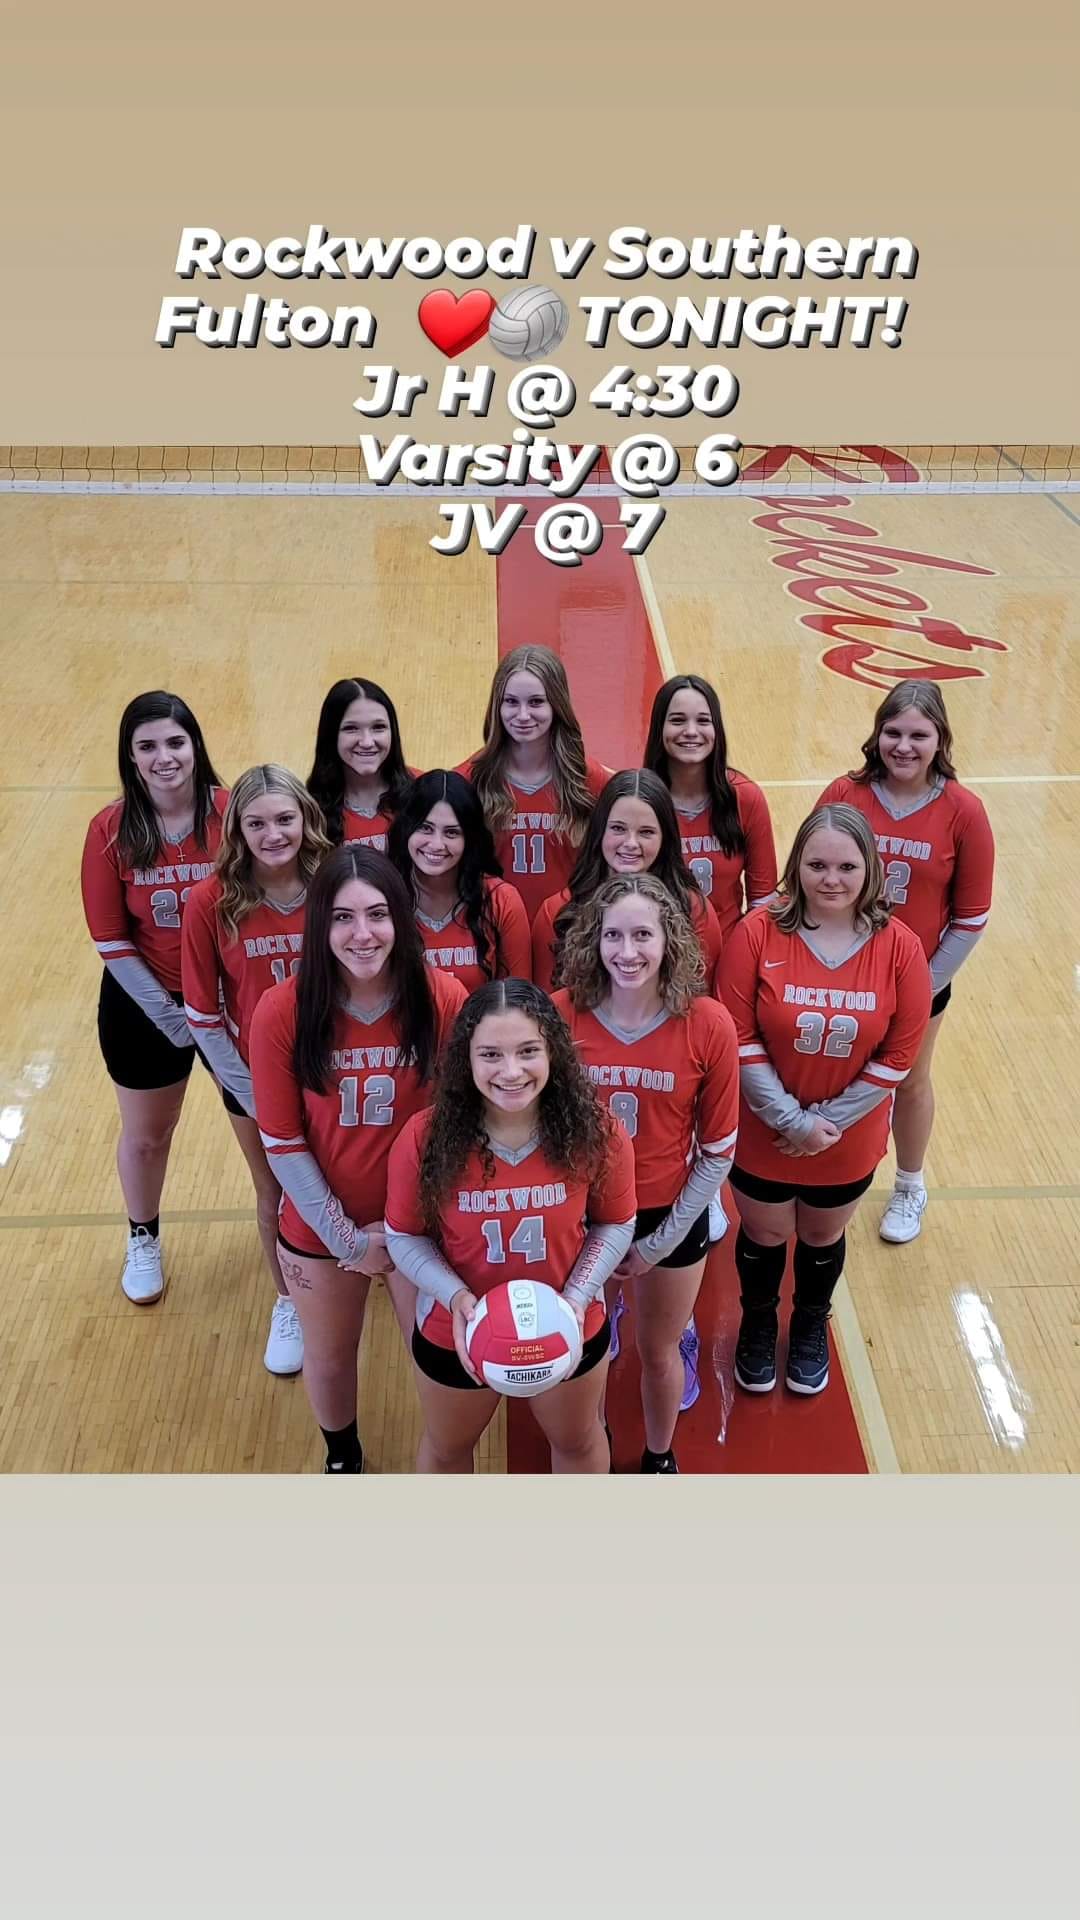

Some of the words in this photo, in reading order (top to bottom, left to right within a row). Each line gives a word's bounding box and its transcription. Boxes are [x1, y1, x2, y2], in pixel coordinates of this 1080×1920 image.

[512, 834, 546, 873] 11
[880, 860, 912, 905] 2
[243, 933, 304, 958] ROCKW
[783, 983, 876, 1012] ROCKWOOD
[793, 1011, 859, 1058] 32
[338, 1074, 396, 1127] 12
[457, 1182, 568, 1213] ROCKWOOD
[480, 1215, 547, 1264] 14
[574, 1239, 605, 1286] ROCKETS
[510, 1344, 545, 1354] OFFICIAL
[503, 1364, 554, 1381] TACHIKARA
